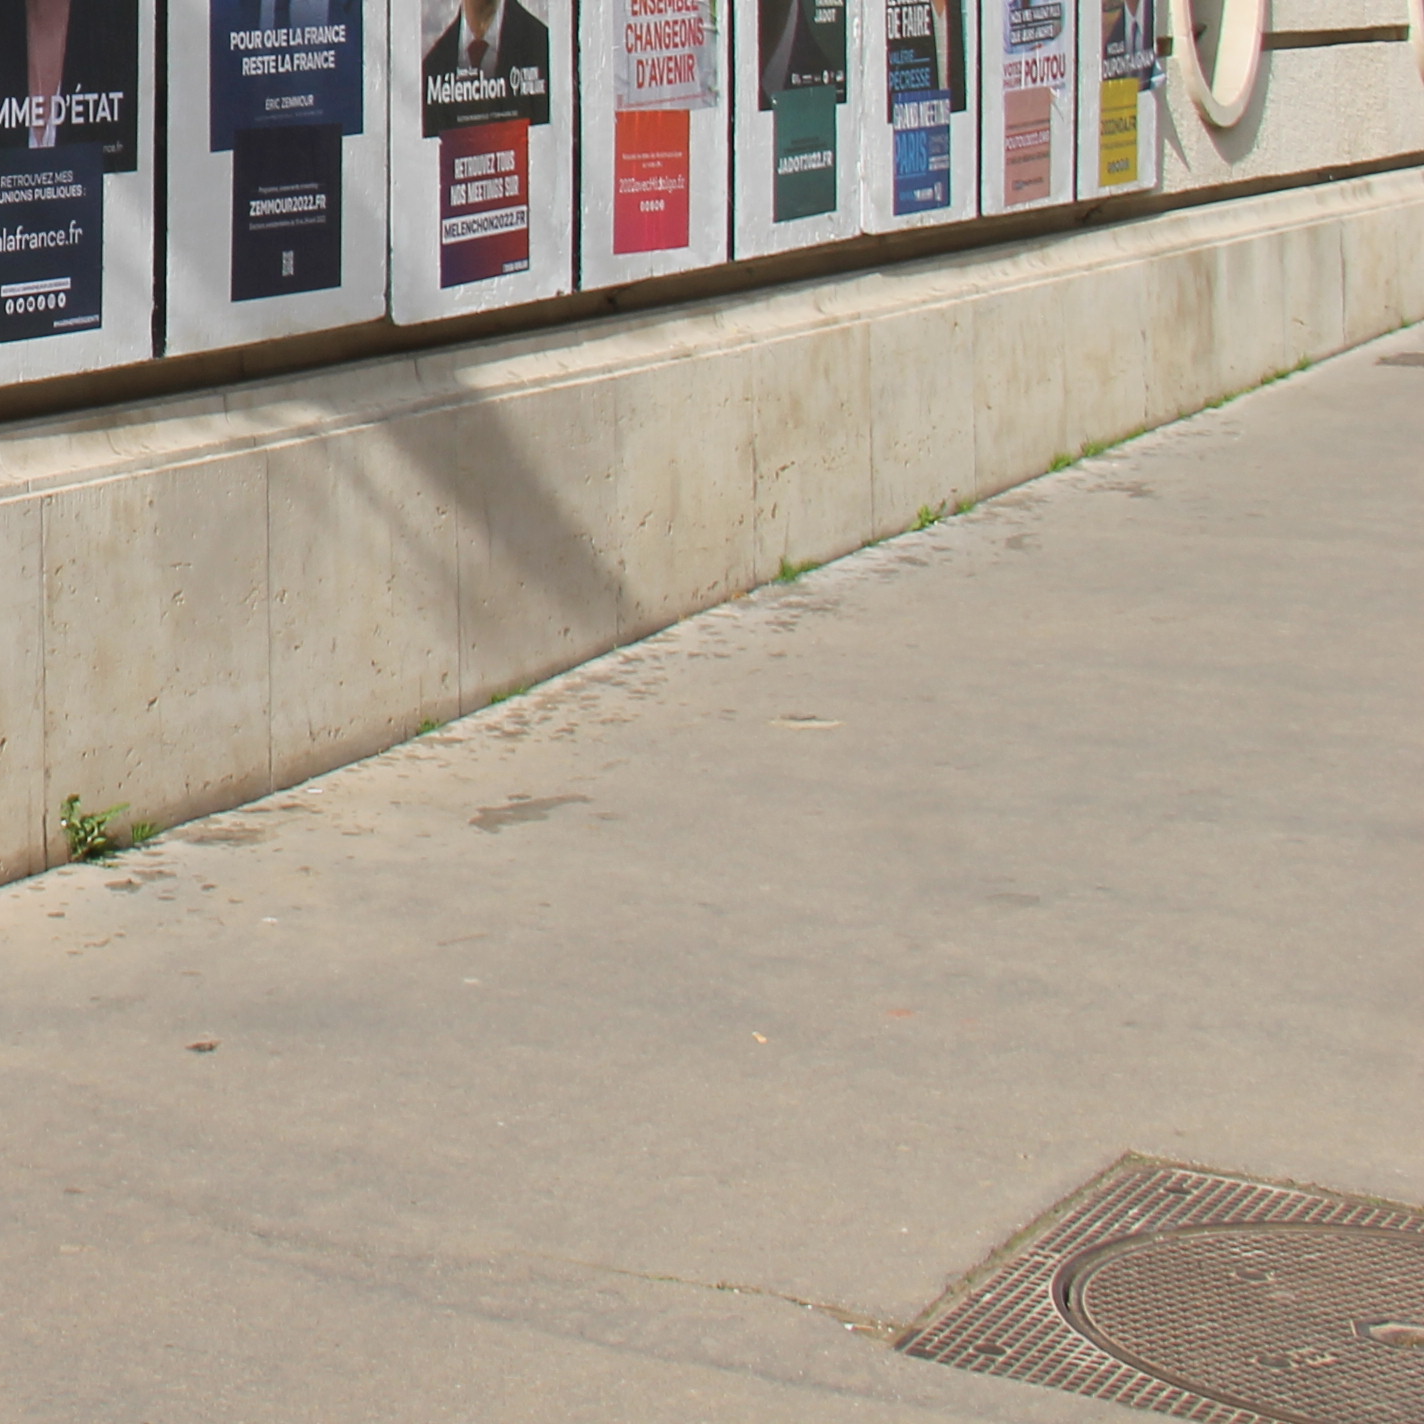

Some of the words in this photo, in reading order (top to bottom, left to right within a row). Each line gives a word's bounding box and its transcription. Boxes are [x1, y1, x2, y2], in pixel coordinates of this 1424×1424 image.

[625, 17, 704, 54] CHANGEONS
[887, 7, 901, 39] DE
[902, 4, 930, 38] FAIRE
[230, 30, 262, 50] POUR
[263, 29, 288, 48] QUE
[288, 27, 303, 46] LA
[304, 25, 346, 44] FRANCE
[242, 54, 278, 76] RESTE
[278, 54, 292, 73] LA
[293, 51, 335, 71] FRANCE
[635, 53, 696, 90] D'AVENIR
[1025, 54, 1065, 84] POUTOU
[427, 70, 506, 105] Mélenchon
[52, 83, 124, 126] D'ÉTAT
[895, 131, 927, 175] PARIS
[0, 172, 53, 188] RETROUVEZ
[55, 170, 73, 183] MES
[34, 184, 83, 200] PUBLIQUES
[249, 194, 326, 216] ZEMMOUR2022.FR
[444, 210, 525, 239] MELENCHON2022.FR
